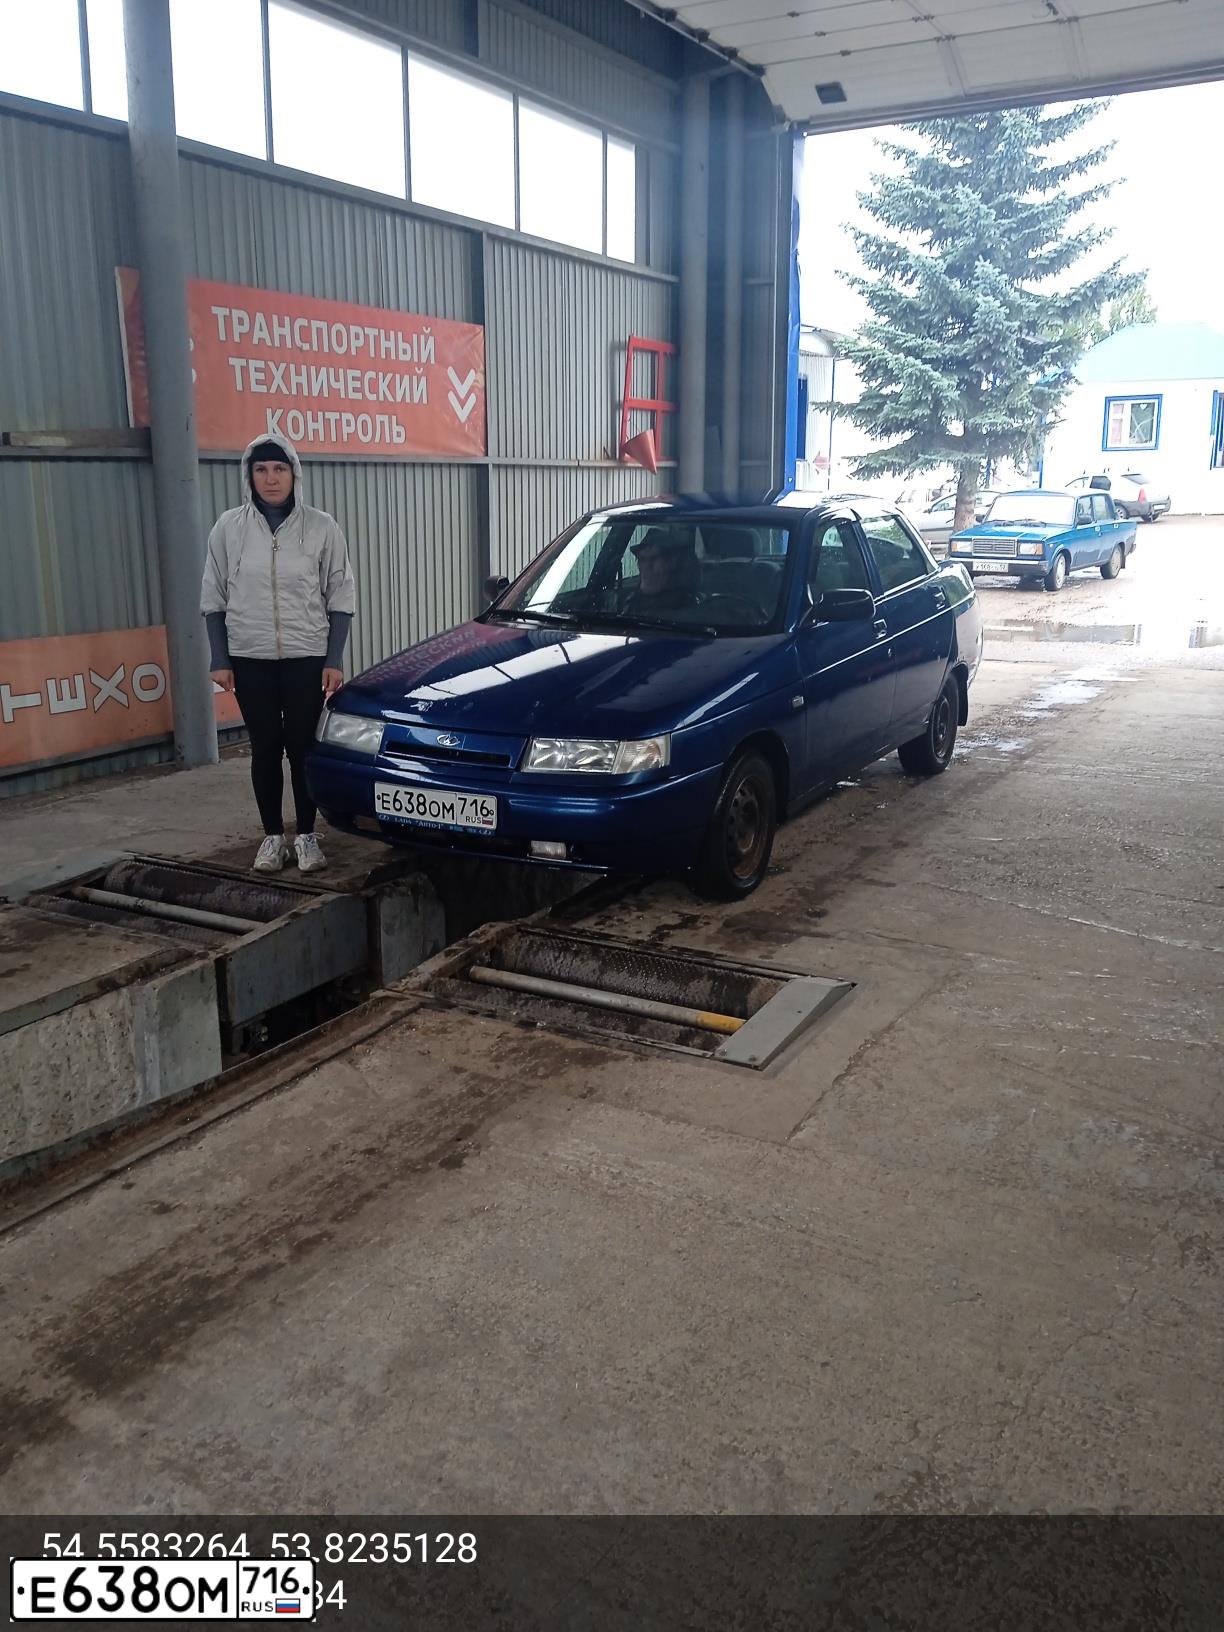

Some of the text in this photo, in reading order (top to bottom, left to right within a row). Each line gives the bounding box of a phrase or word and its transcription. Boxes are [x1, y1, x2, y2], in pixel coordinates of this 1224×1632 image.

[211, 305, 436, 365] ТРАНСПОРТНЫЙ
[228, 357, 428, 404] ТЕХНИЧЕСКИЙ
[266, 407, 406, 444] КОНТРОЛЬ
[465, 816, 482, 824] RUS
